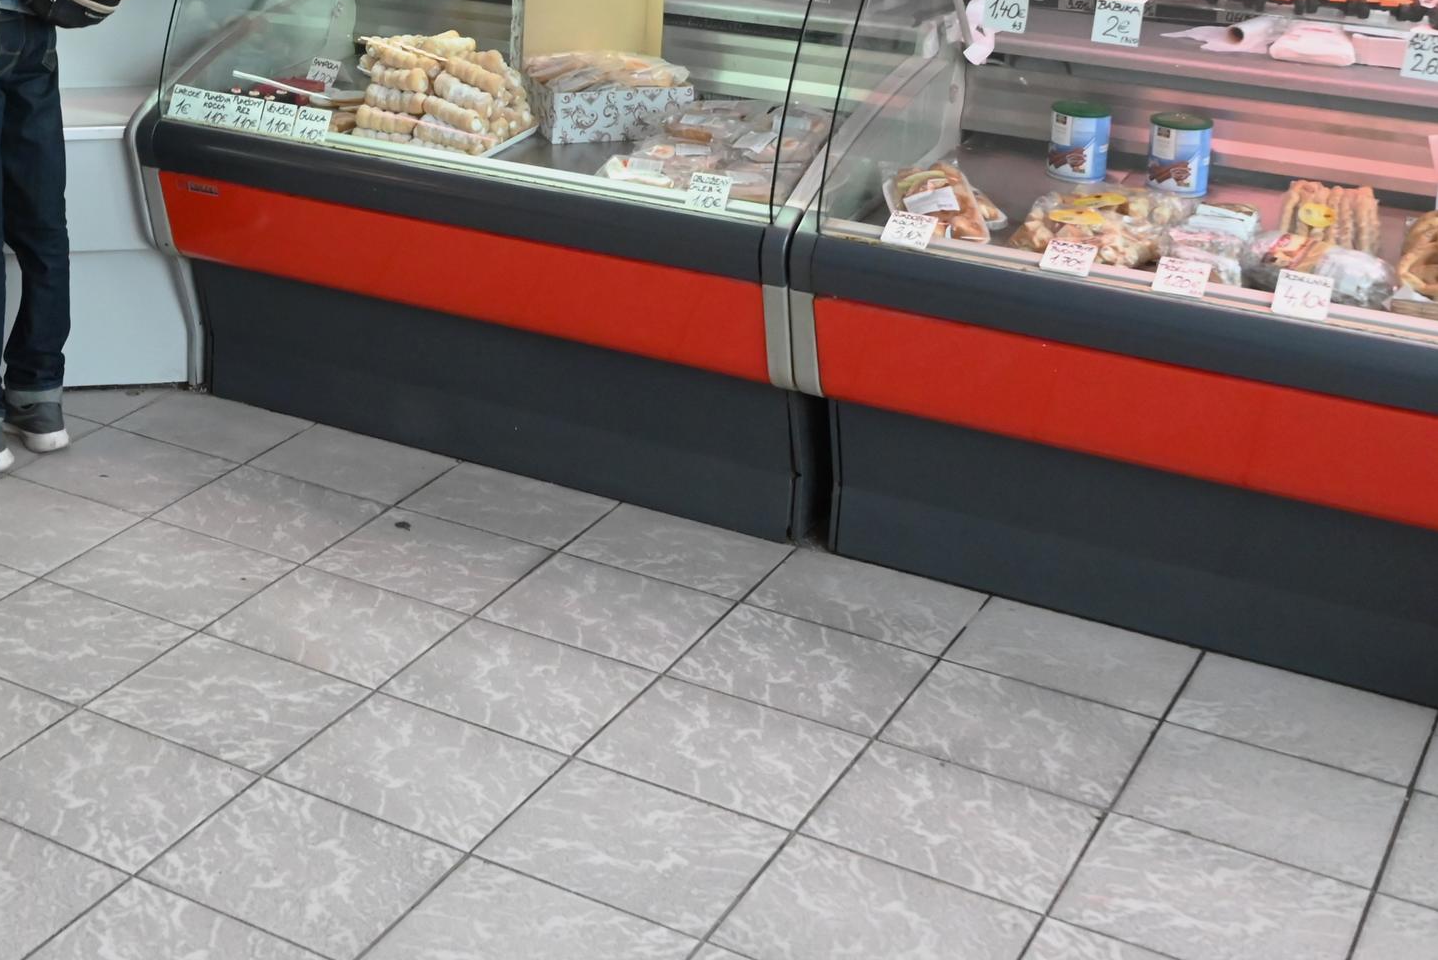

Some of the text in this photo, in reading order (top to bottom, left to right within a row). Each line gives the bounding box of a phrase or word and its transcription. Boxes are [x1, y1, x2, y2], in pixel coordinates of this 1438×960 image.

[988, 0, 1026, 20] 1,40€
[1102, 15, 1130, 38] 2€
[175, 99, 192, 115] 1€
[265, 119, 291, 134] 1,10€
[692, 194, 722, 210] 1,10€
